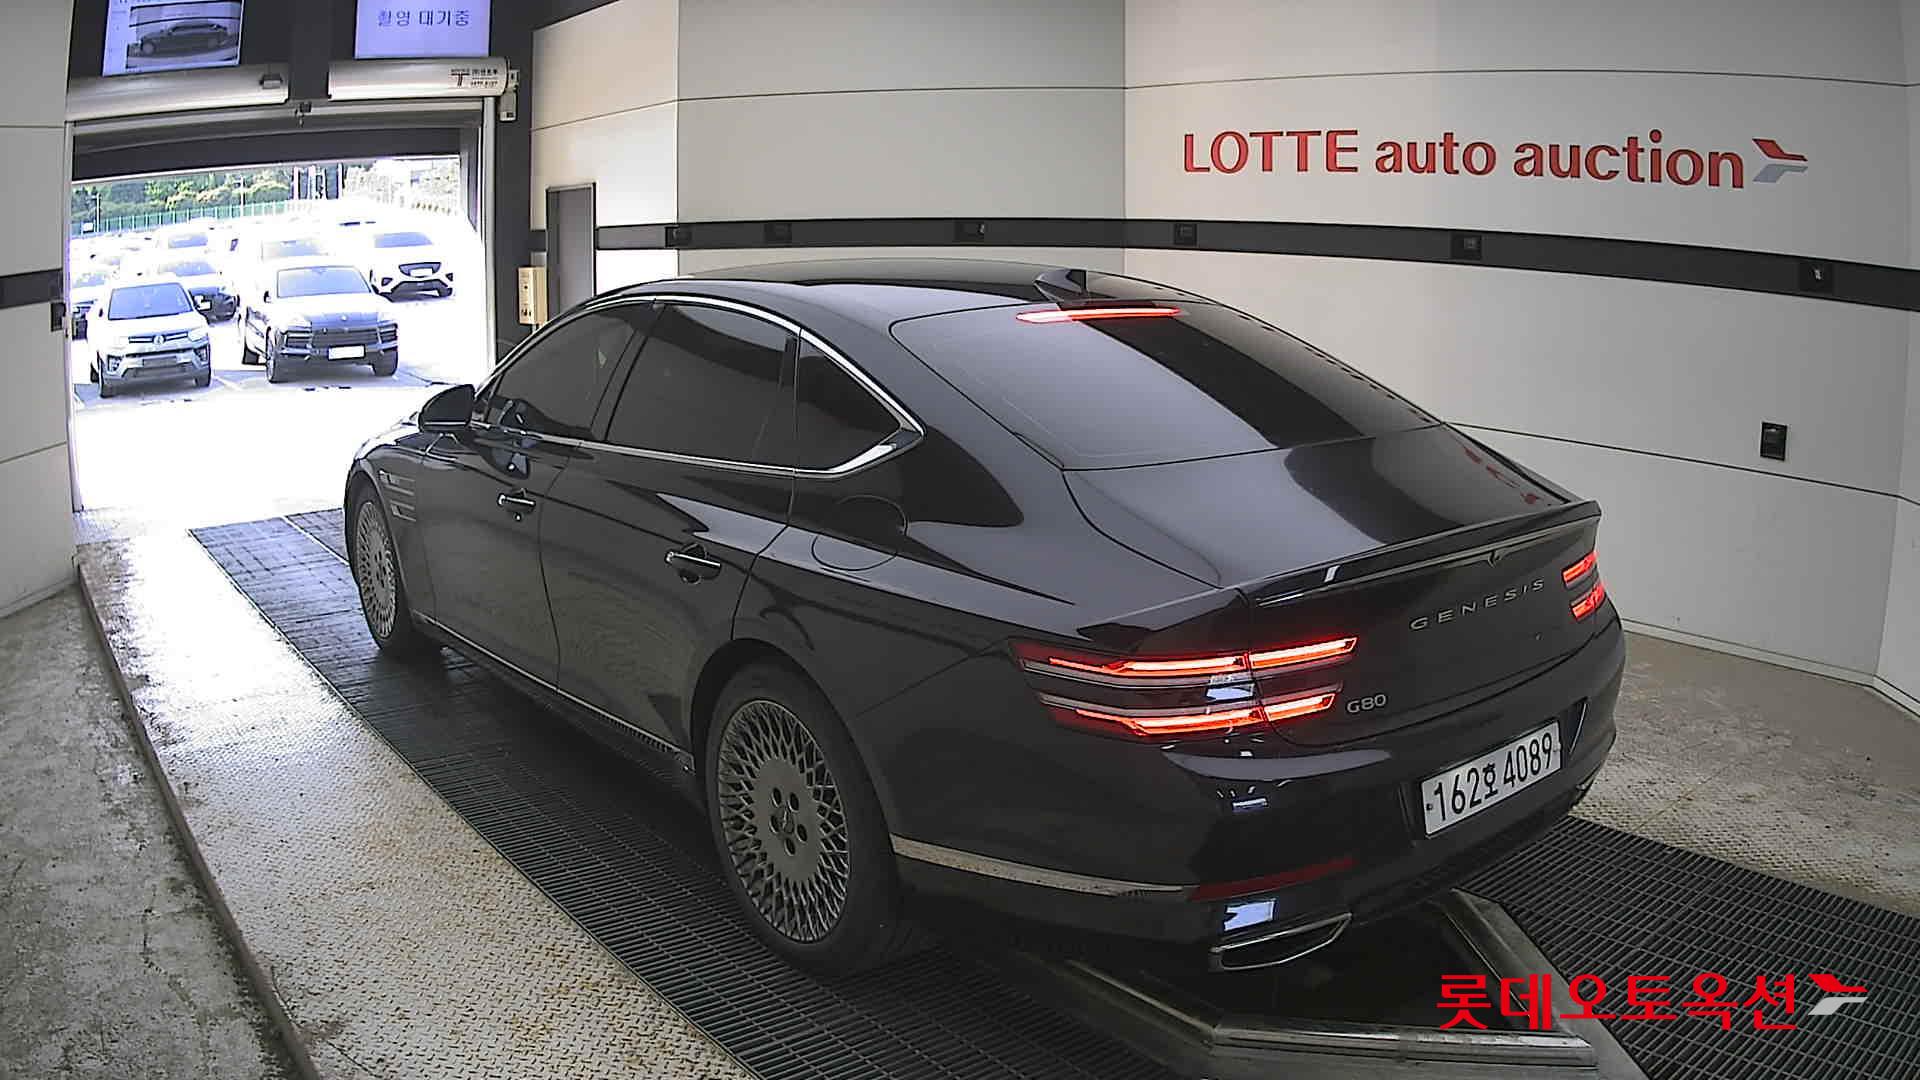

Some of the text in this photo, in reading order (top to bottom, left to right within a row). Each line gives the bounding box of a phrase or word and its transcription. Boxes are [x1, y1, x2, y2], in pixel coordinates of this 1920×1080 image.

[418, 10, 470, 26] 대기중
[1184, 129, 1744, 188] LOTTE auto auction
[1410, 578, 1545, 631] GENESIS
[1347, 694, 1386, 713] G80
